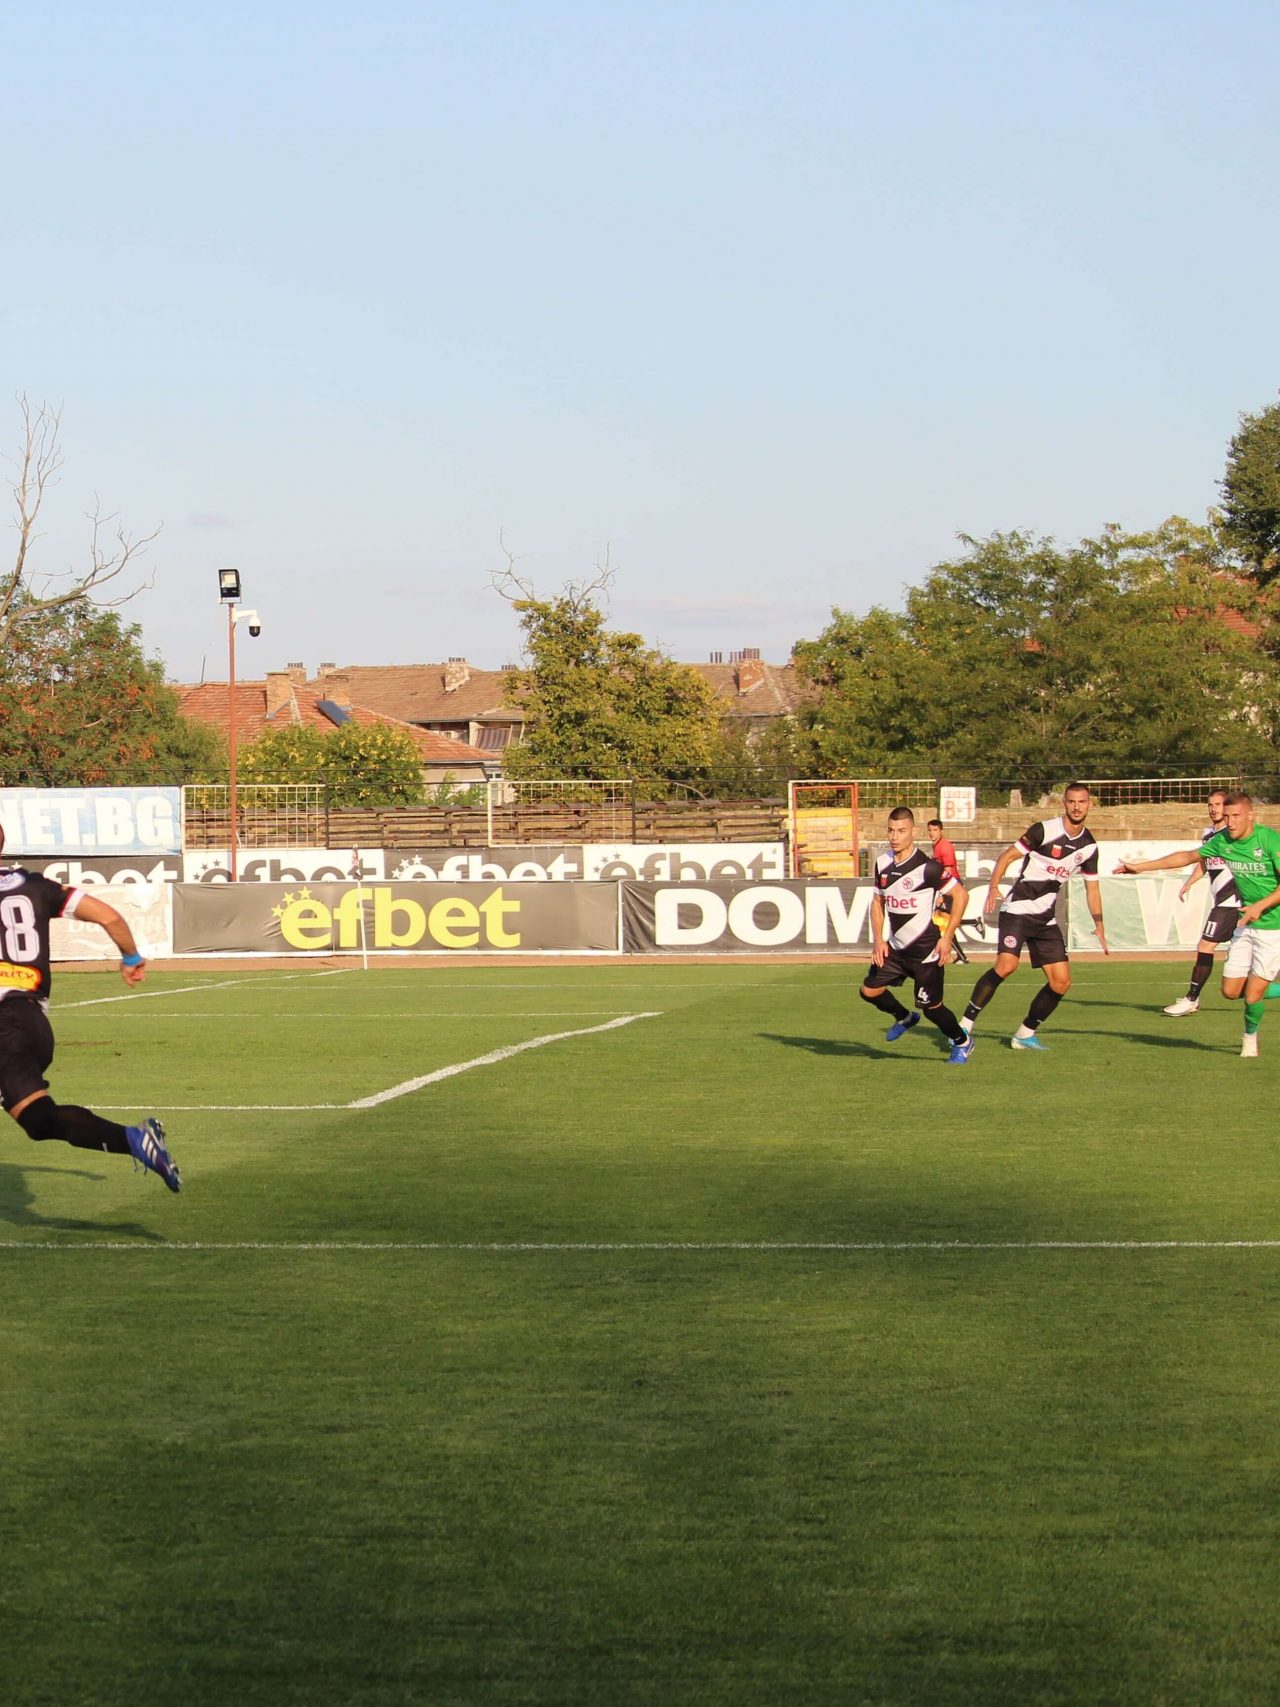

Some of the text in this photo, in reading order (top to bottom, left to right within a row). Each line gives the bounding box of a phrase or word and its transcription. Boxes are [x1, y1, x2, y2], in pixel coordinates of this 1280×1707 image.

[886, 895, 918, 909] fbet
[280, 886, 520, 949] efbet
[1206, 921, 1217, 935] 11
[918, 987, 928, 1000] 4
